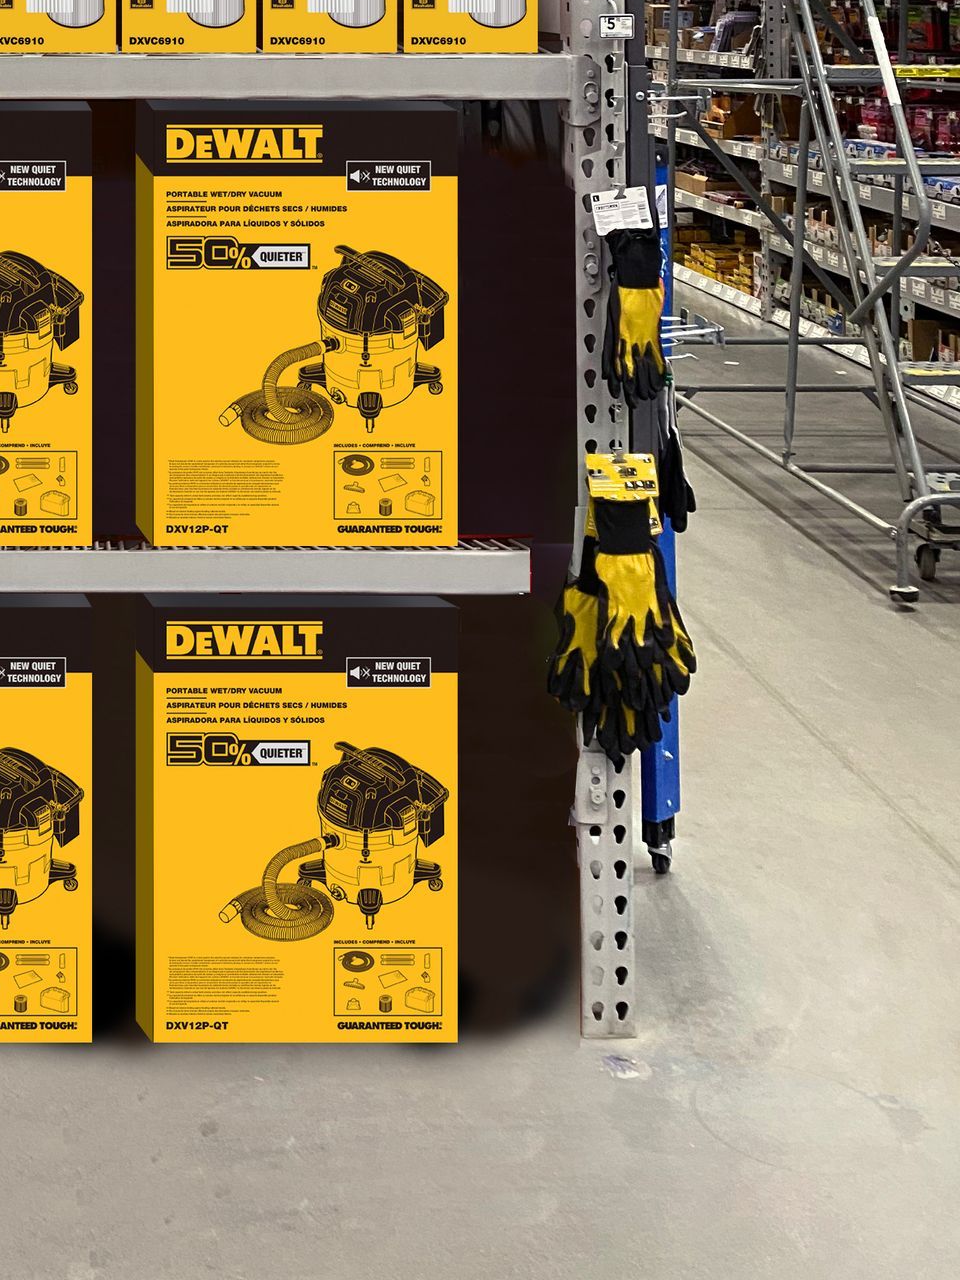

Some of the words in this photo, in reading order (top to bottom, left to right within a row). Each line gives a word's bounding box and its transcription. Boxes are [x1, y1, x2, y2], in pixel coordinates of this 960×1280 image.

[130, 36, 186, 46] DXVC6910
[270, 36, 326, 46] DXVC6910
[411, 36, 467, 46] DXVC6910
[11, 165, 30, 174] NEW
[32, 165, 57, 175] QUIET
[7, 177, 62, 187] TECHNOLOGY
[167, 236, 252, 270] 50%
[260, 251, 304, 263] QUIETER
[166, 525, 230, 534] DXV12P-QT
[167, 733, 252, 767] 50%
[260, 748, 304, 760] QUIETER
[166, 1022, 230, 1031] DXV12P-QT
